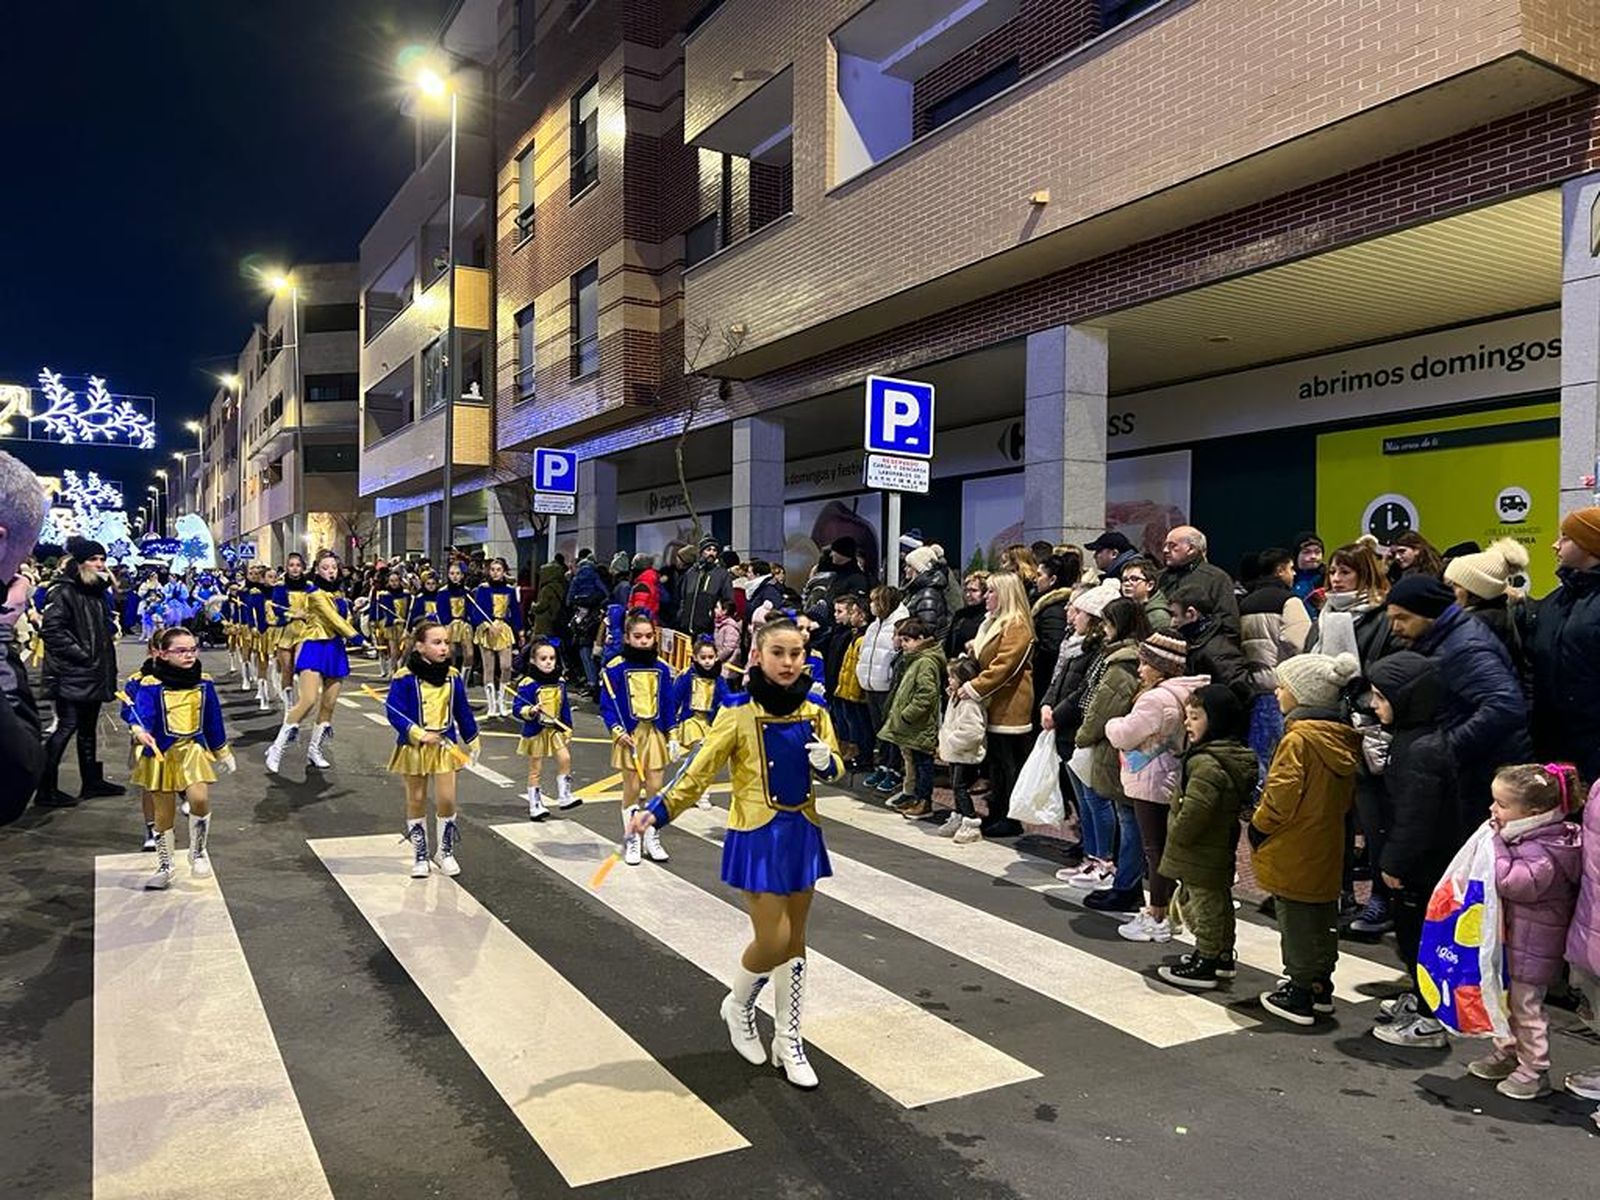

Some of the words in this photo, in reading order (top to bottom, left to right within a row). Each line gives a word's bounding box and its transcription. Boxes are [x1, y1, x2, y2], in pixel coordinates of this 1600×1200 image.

[1299, 367, 1404, 399] abrimos
[1411, 338, 1561, 380] domingos
[883, 389, 920, 442] P
[543, 454, 569, 487] P
